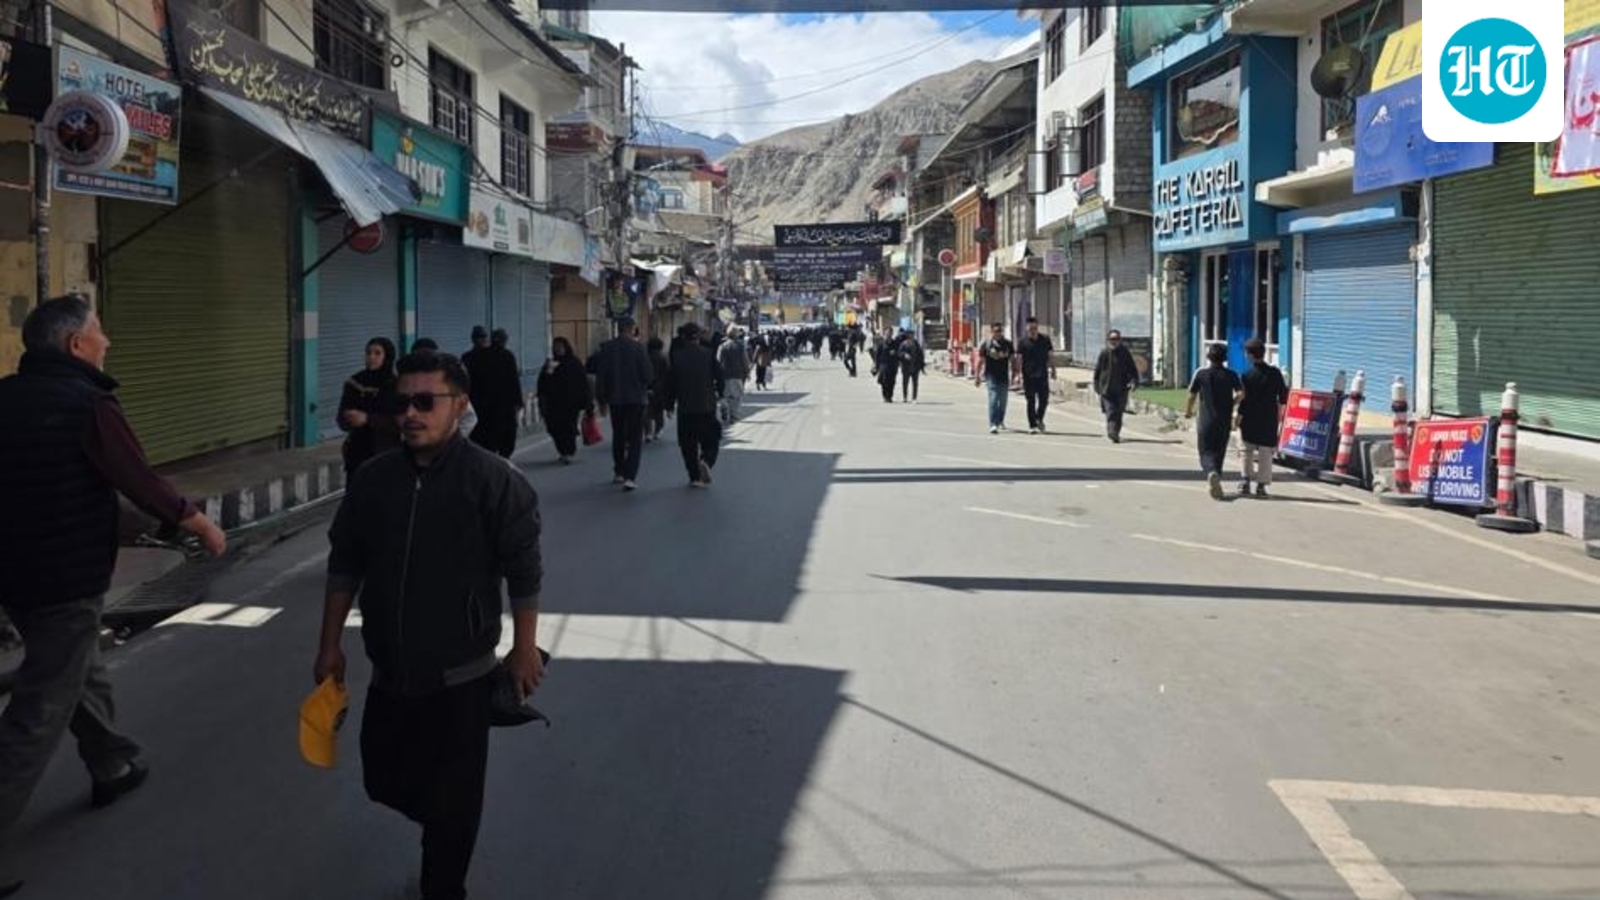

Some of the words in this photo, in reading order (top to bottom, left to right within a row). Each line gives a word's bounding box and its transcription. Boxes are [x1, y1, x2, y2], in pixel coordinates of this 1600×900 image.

[105, 72, 147, 102] HOTEL
[1154, 176, 1181, 205] THE
[1186, 159, 1243, 198] KARGIL
[1154, 195, 1243, 238] CAFETERIA
[1444, 448, 1464, 463] NOT
[1437, 465, 1474, 480] MOBILE
[1440, 481, 1480, 499] DRIVING
